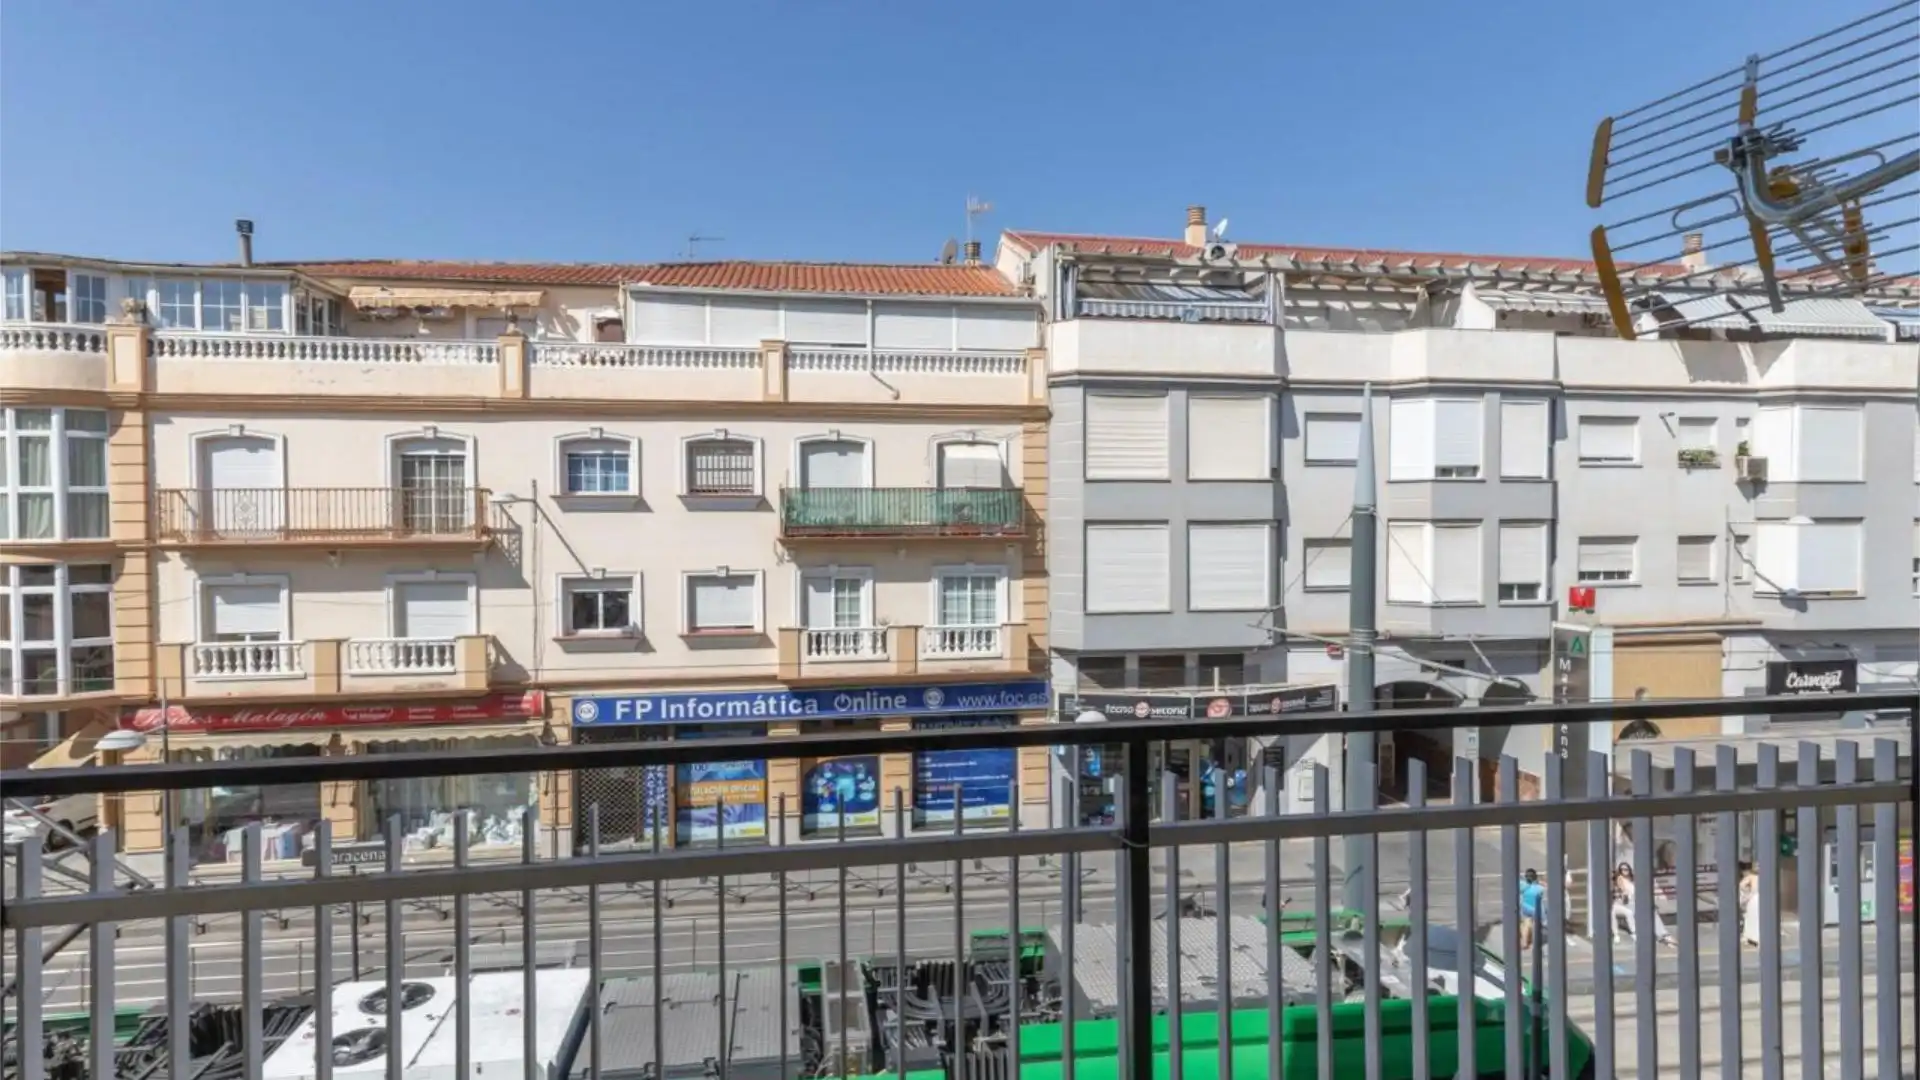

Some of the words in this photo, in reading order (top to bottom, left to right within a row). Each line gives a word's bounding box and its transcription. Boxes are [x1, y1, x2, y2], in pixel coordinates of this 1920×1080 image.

[222, 707, 327, 727] Malagón
[615, 700, 653, 720] FP
[661, 696, 819, 719] Informática
[330, 850, 387, 865] aracena
